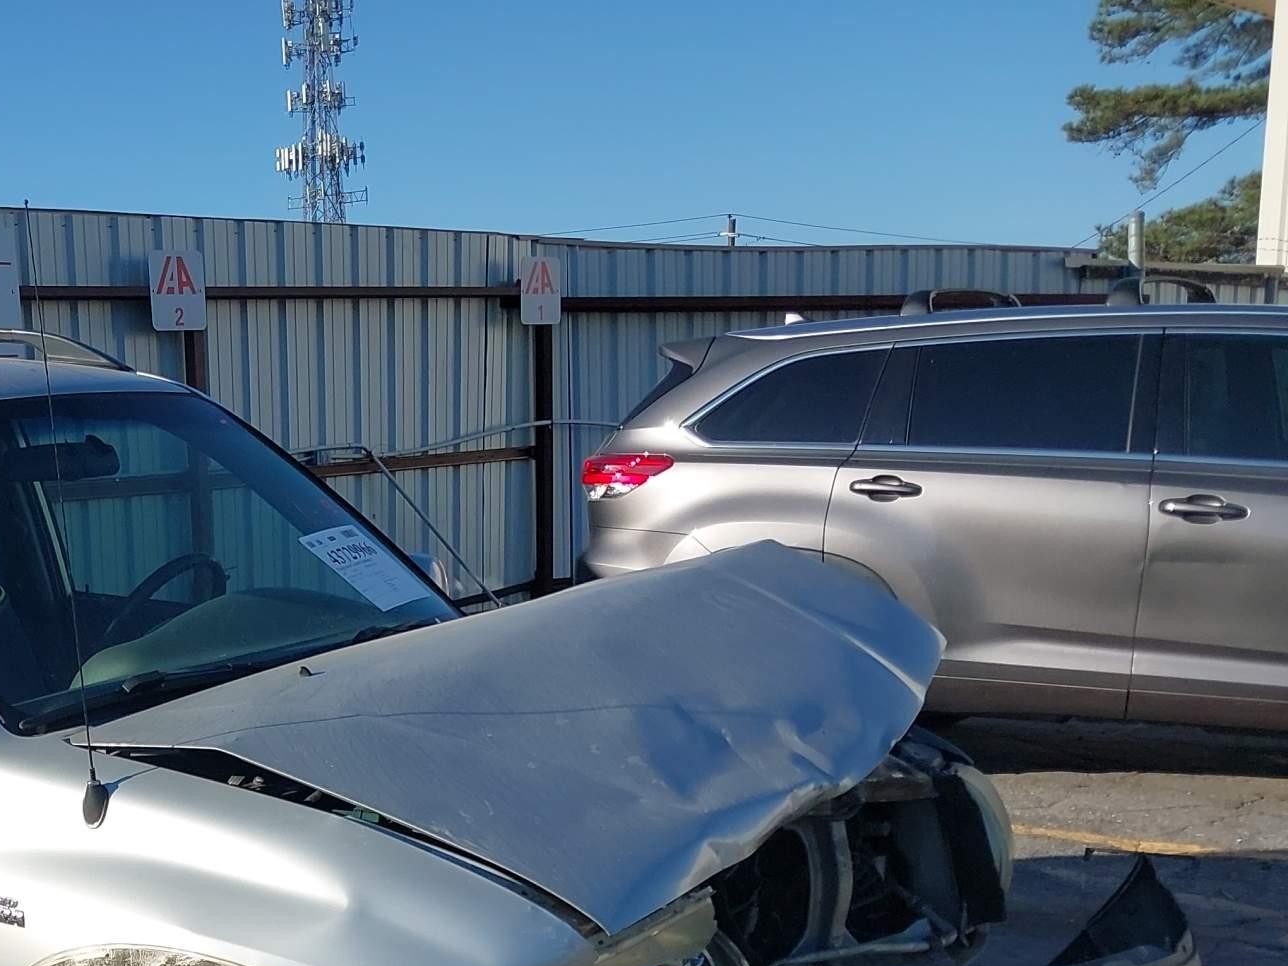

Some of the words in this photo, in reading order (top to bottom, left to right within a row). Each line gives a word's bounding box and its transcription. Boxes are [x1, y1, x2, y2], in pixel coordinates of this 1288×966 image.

[174, 307, 185, 327] 2
[537, 305, 544, 321] 1
[326, 541, 378, 567] 43729966
